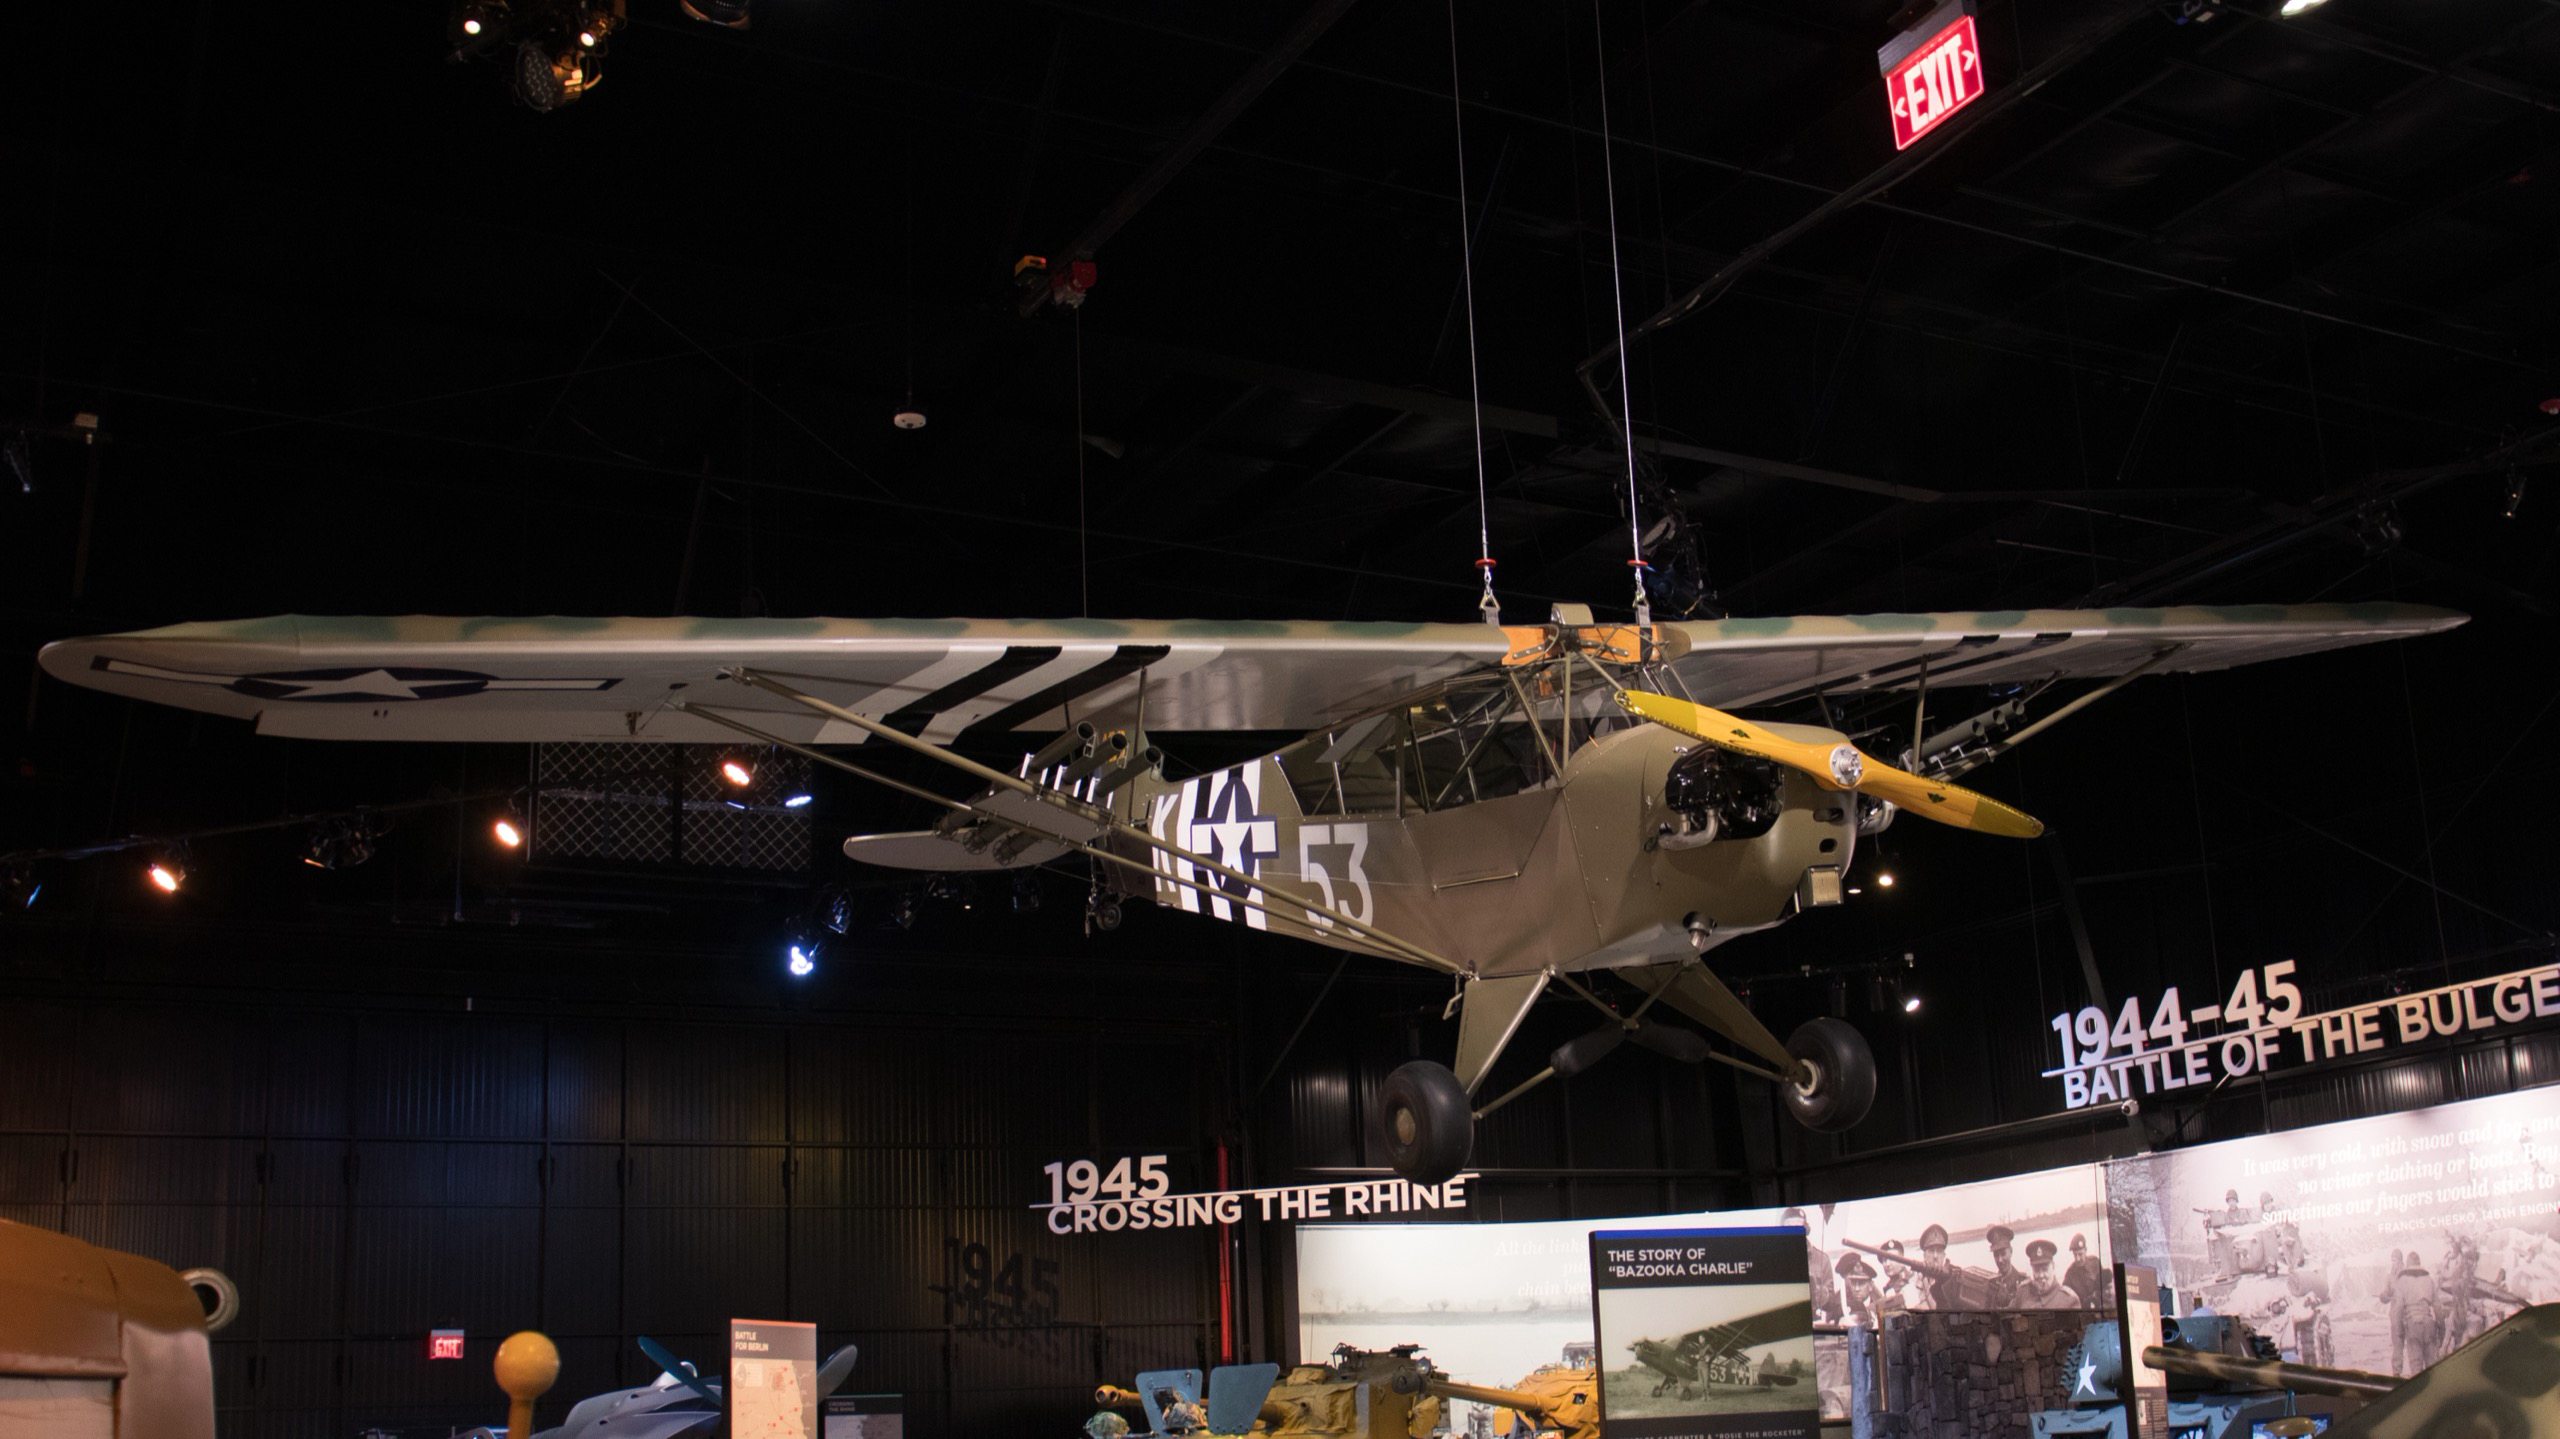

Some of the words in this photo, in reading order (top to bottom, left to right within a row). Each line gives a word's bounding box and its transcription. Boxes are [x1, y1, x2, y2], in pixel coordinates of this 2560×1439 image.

[1904, 34, 1966, 133] EXIT
[1299, 822, 1374, 938] 53
[2051, 959, 2301, 1068] 1944-45
[2063, 1043, 2212, 1109] BATTLE
[2221, 1028, 2281, 1077] OF
[2292, 1006, 2385, 1062] THE
[2397, 971, 2560, 1044] BULGE
[2242, 1157, 2257, 1177] It
[2259, 1155, 2290, 1175] was
[2292, 1150, 2328, 1172] very
[2370, 1135, 2409, 1159] with
[2410, 1131, 2454, 1152] snow
[2458, 1119, 2491, 1144] and
[1043, 1155, 1170, 1206] 1945
[2260, 1195, 2344, 1226] sometimes
[2345, 1198, 2374, 1216] our
[2375, 1187, 2433, 1216] fingers
[2436, 1177, 2489, 1204] would
[2492, 1169, 2535, 1196] stick
[2537, 1171, 2555, 1190] to
[2297, 1177, 2319, 1196] no
[2321, 1167, 2374, 1192] winter
[2376, 1157, 2443, 1185] clothing
[2446, 1155, 2467, 1175] or
[1047, 1194, 1243, 1235] CROSSING
[1255, 1187, 1332, 1221] THE
[1345, 1177, 1467, 1215] RHINE
[2377, 1217, 2426, 1234] FRANCIS
[1608, 1250, 1636, 1263] THE
[1638, 1248, 1683, 1262] STORY
[1686, 1248, 1706, 1260] OF
[1608, 1263, 1686, 1278] "BAZOOKA
[1689, 1261, 1753, 1276] CHARLIE"
[435, 1338, 462, 1358] EXIT
[735, 1330, 757, 1341] BATTLE
[735, 1341, 747, 1351] FOR
[748, 1342, 769, 1352] BERLIN
